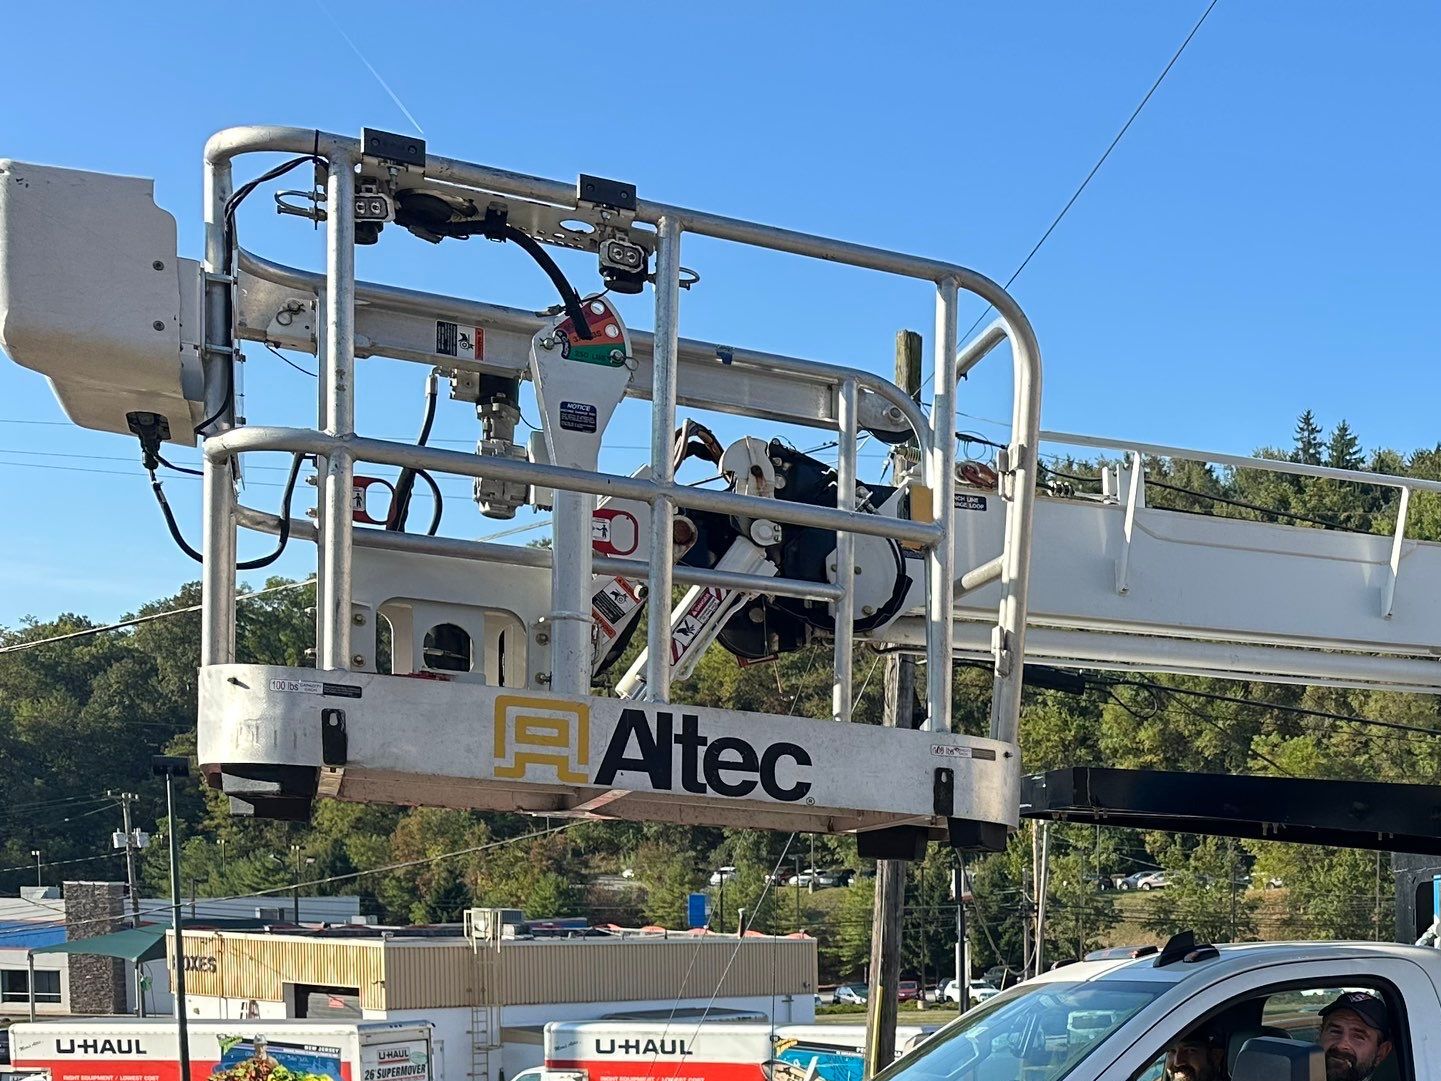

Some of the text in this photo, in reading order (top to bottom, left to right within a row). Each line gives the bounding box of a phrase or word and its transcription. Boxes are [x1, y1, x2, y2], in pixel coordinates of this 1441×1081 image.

[567, 403, 591, 411] NOTICE
[272, 680, 299, 691] 100 lbs
[594, 706, 813, 801] Altec
[56, 1039, 147, 1054] U-HAUL
[318, 1045, 340, 1054] JERSEY
[596, 1039, 693, 1055] U-HAUL
[379, 1049, 409, 1060] U-HAUL
[377, 1064, 426, 1079] SUPERMOVER
